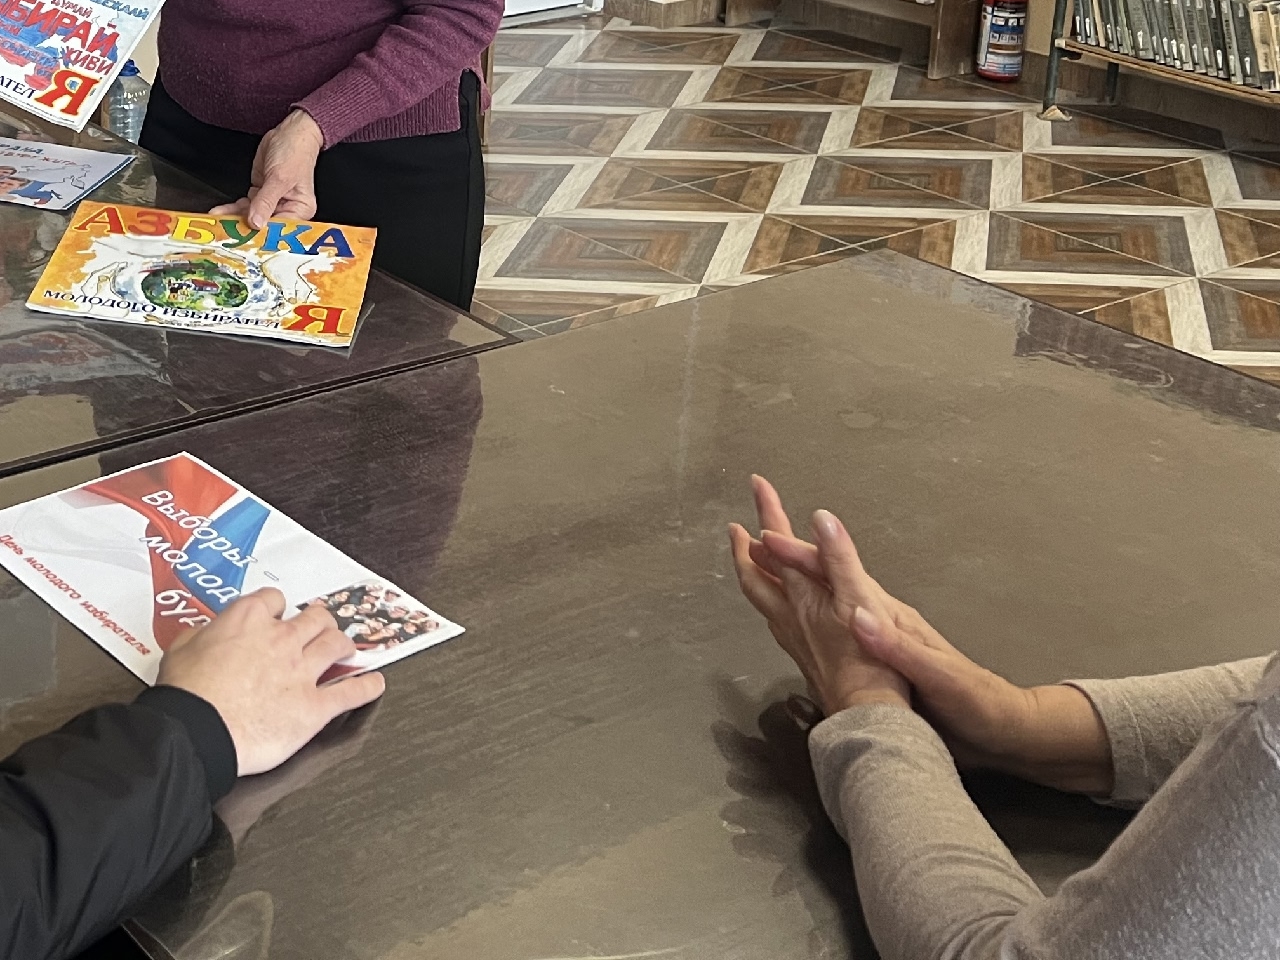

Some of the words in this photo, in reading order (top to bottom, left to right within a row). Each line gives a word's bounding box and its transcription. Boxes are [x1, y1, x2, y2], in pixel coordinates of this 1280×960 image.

[61, 45, 115, 76] ЖИВИ
[74, 207, 355, 258] АЗБУКА
[43, 289, 158, 314] МОЛОДОГО
[141, 490, 258, 568] Выборы
[139, 534, 242, 604] молод
[25, 556, 82, 601] молодого
[80, 599, 151, 657] избирателя
